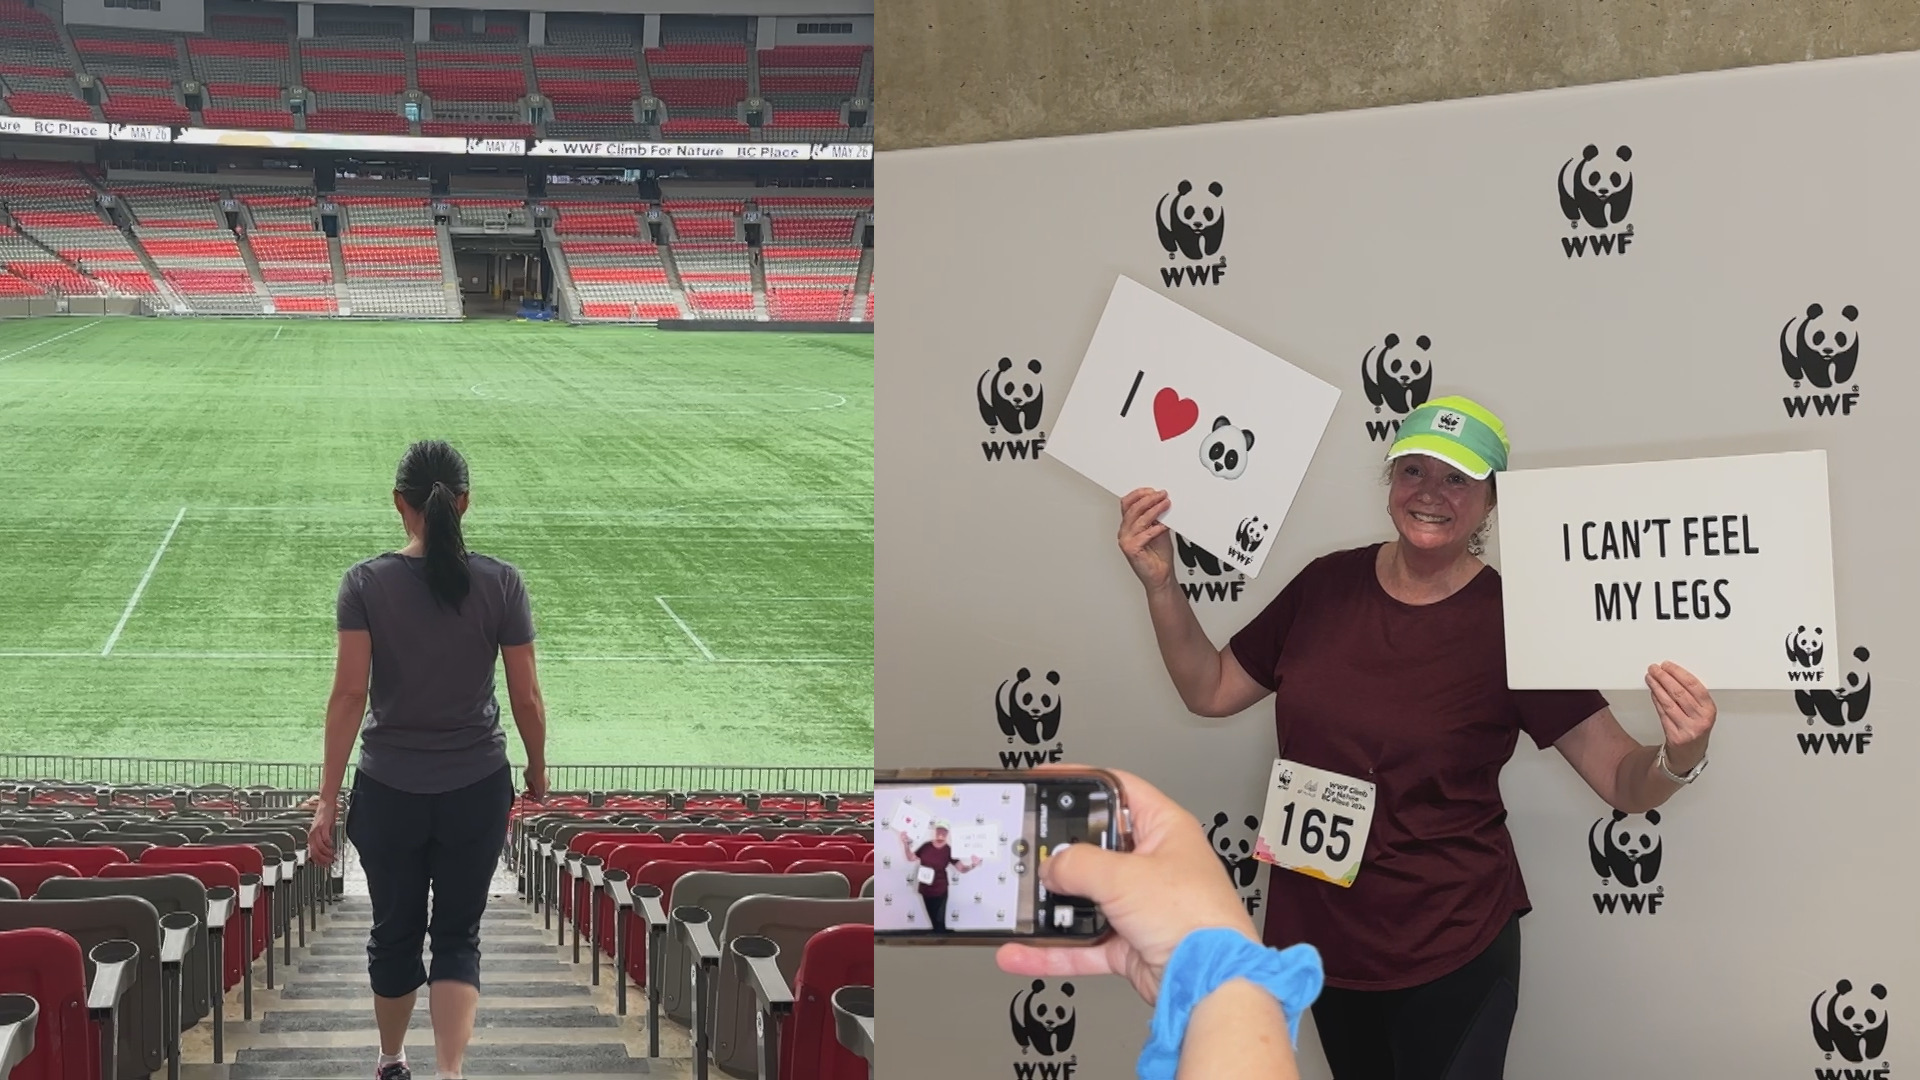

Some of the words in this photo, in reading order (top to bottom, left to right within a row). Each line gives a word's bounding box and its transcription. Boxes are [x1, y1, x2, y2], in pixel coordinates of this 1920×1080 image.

[34, 120, 55, 134] BC
[58, 123, 98, 136] Place
[131, 127, 151, 140] MAY
[485, 140, 506, 153] MAY
[563, 143, 602, 155] WWF
[607, 142, 646, 156] Climb
[651, 145, 674, 156] For
[676, 145, 724, 157] Nature
[760, 146, 799, 158] Place
[832, 147, 852, 158] MAY
[1561, 232, 1634, 259] WWF
[1160, 264, 1227, 288] WWF
[1120, 369, 1145, 418] I
[1782, 393, 1860, 418] WWF
[981, 439, 1046, 462] WWF
[1562, 523, 1570, 562] I
[1581, 518, 1671, 561] CAN'T
[1683, 514, 1760, 556] FEEL
[1180, 581, 1245, 602] WWF
[1594, 581, 1642, 621] MY
[1654, 578, 1732, 620] LEGS
[1787, 671, 1824, 682] WWF
[1796, 733, 1873, 755] WWF
[1281, 801, 1355, 863] 165
[1592, 892, 1665, 915] WWF
[1012, 1061, 1078, 1080] WWF
